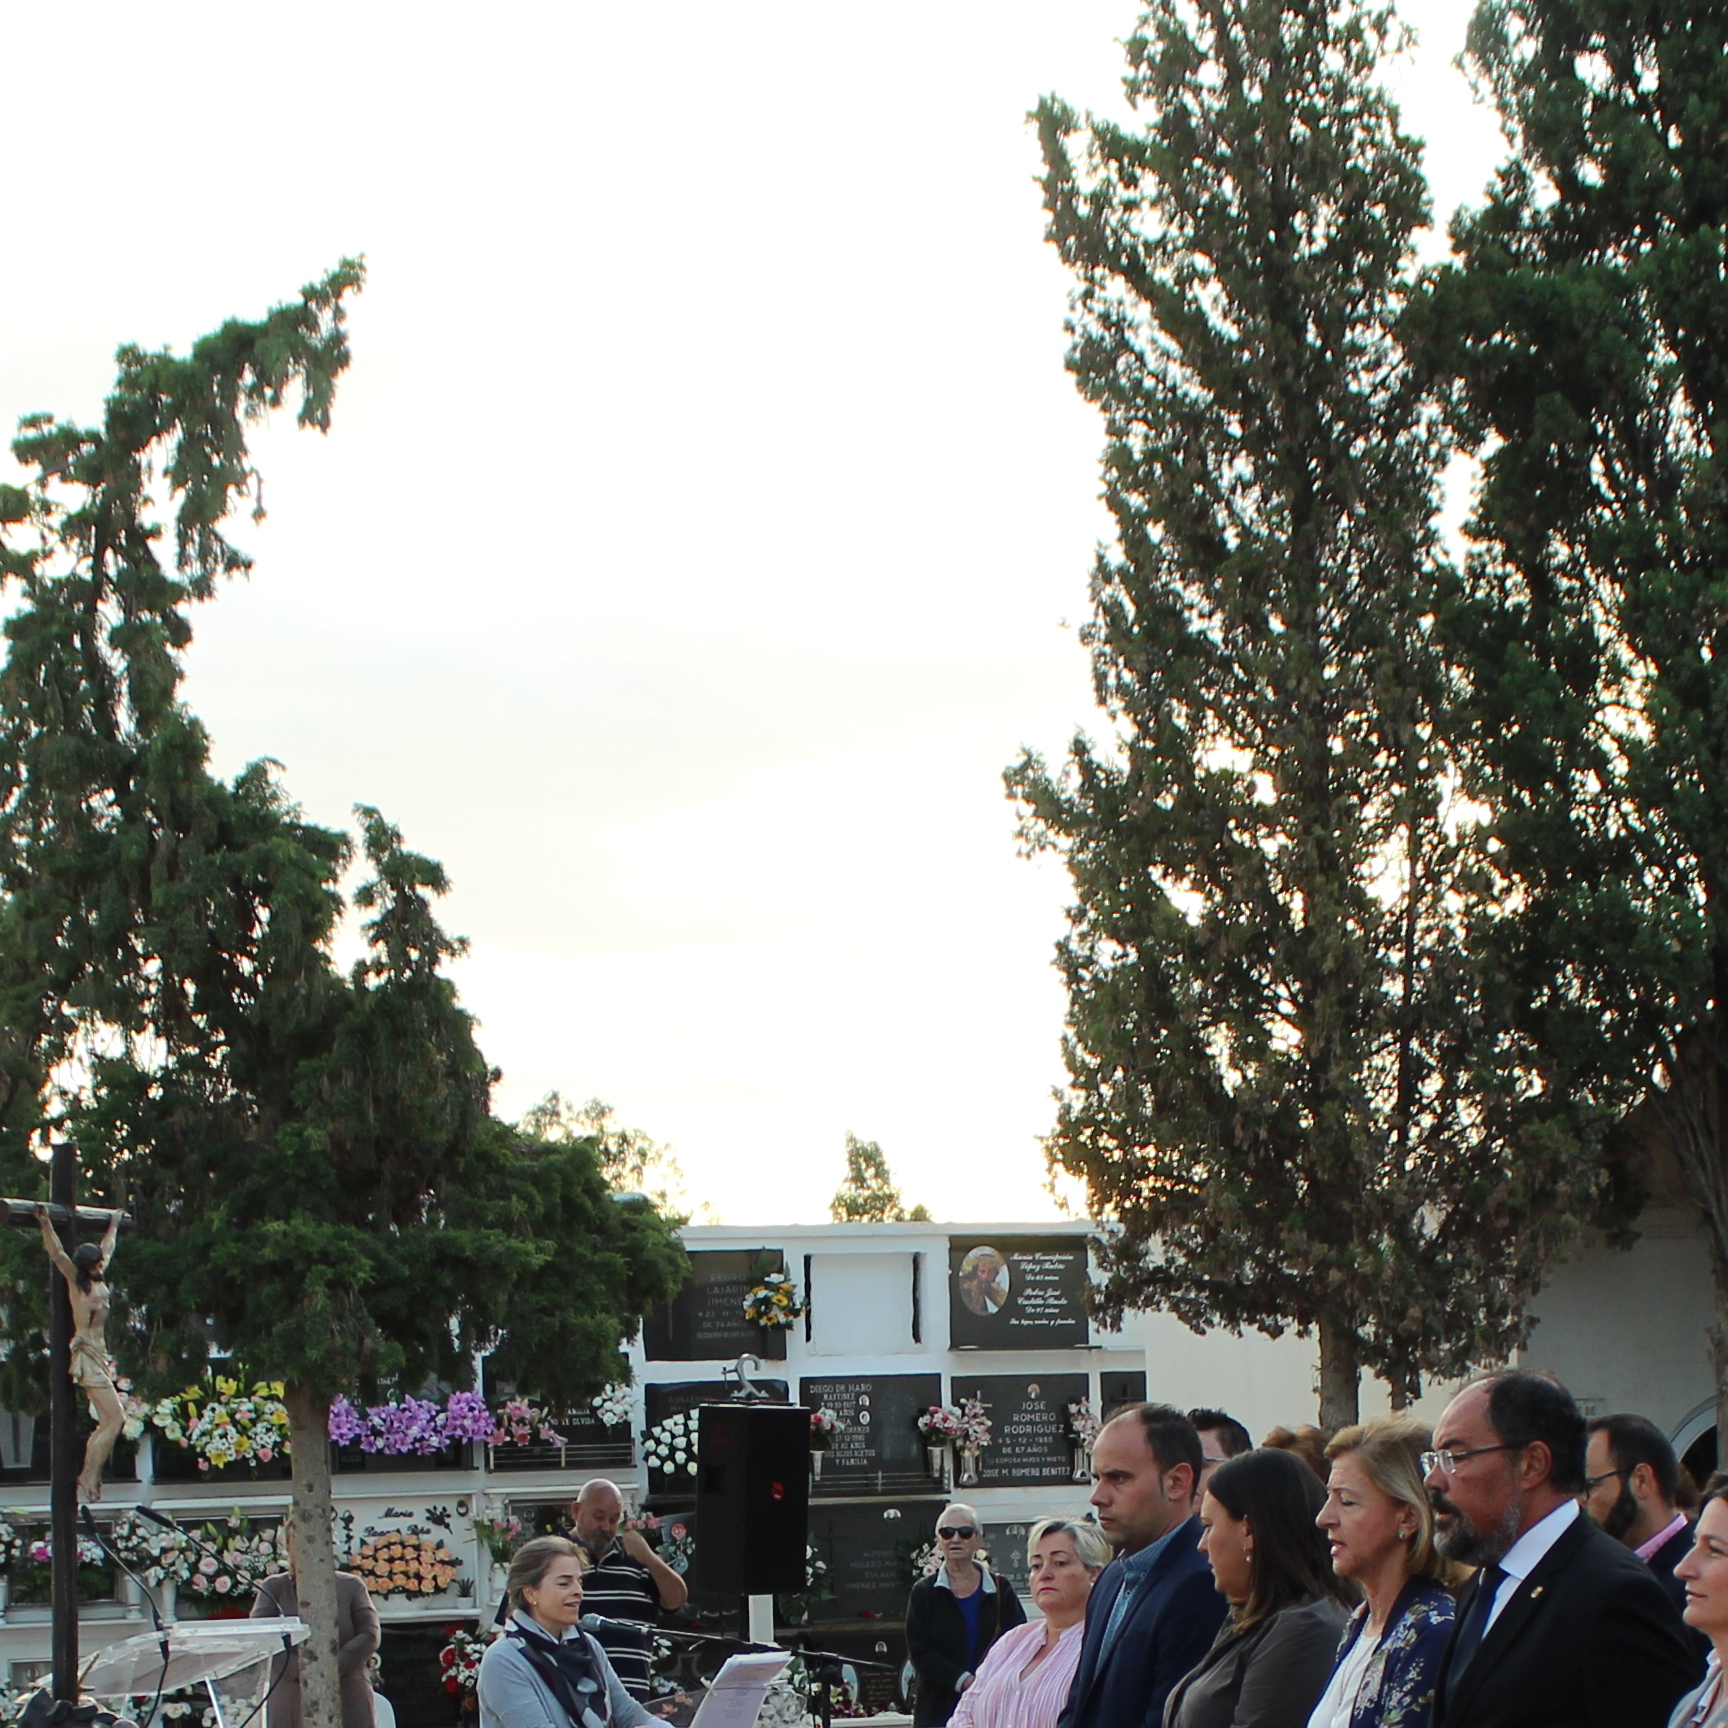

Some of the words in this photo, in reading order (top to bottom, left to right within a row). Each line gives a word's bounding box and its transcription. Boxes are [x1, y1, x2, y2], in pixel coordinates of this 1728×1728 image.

[707, 1297, 744, 1307] JIMENE
[810, 1385, 833, 1393] DIEGO
[836, 1384, 846, 1393] DE
[1021, 1401, 1046, 1410] JOSE
[1013, 1412, 1056, 1422] ROMERO
[1004, 1424, 1065, 1434] RODRIGUEZ
[982, 1469, 1000, 1478] JOSE
